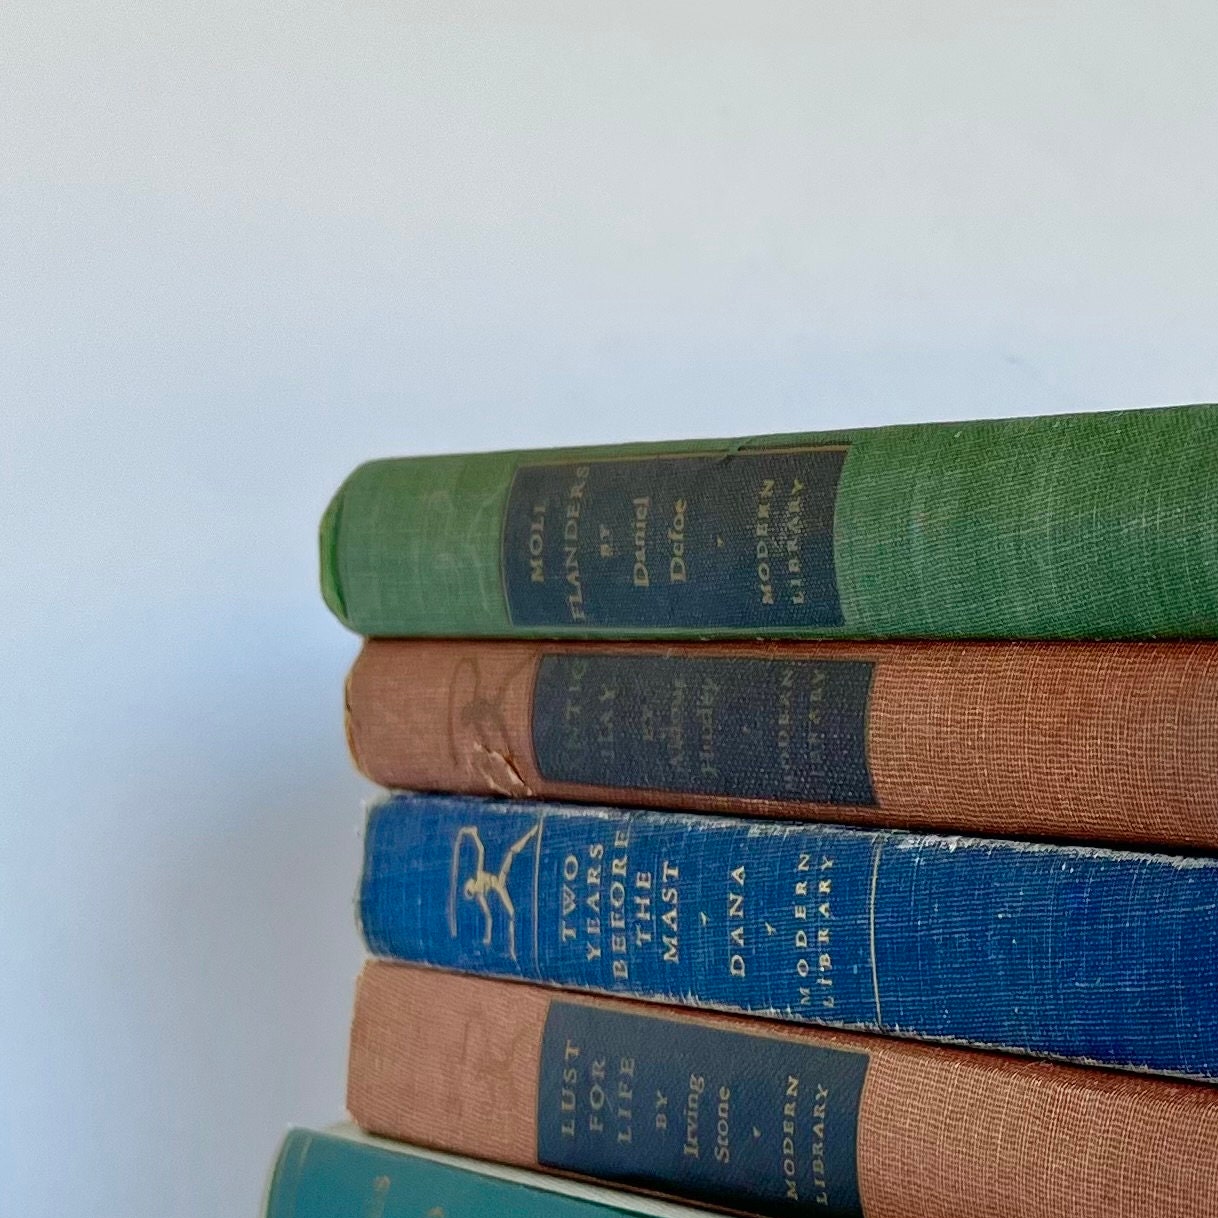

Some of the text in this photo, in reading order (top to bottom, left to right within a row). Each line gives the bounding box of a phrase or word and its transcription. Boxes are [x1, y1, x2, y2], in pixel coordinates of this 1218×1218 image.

[564, 465, 591, 622] FLANDERS
[600, 526, 615, 558] BY
[633, 496, 650, 587] Daniel
[668, 499, 688, 583] Defoe
[756, 479, 776, 606] MODERN
[786, 478, 805, 605] LIBRARY
[560, 855, 579, 943] TWO
[586, 843, 604, 962] YEARS
[609, 829, 630, 981] BEFORE
[636, 871, 652, 947] THE
[661, 861, 680, 964] MAST
[729, 865, 747, 979] DANA
[794, 853, 811, 1006] MODERN
[816, 855, 835, 1009] LIBRARY
[560, 1039, 581, 1138] LUST
[589, 1057, 607, 1132] FOR
[617, 1055, 636, 1144] LIFE
[655, 1090, 668, 1130] BY
[683, 1073, 705, 1159] Irving
[714, 1086, 731, 1164] Stone
[782, 1074, 800, 1201] MODERN
[811, 1083, 830, 1207] LIBRARY
